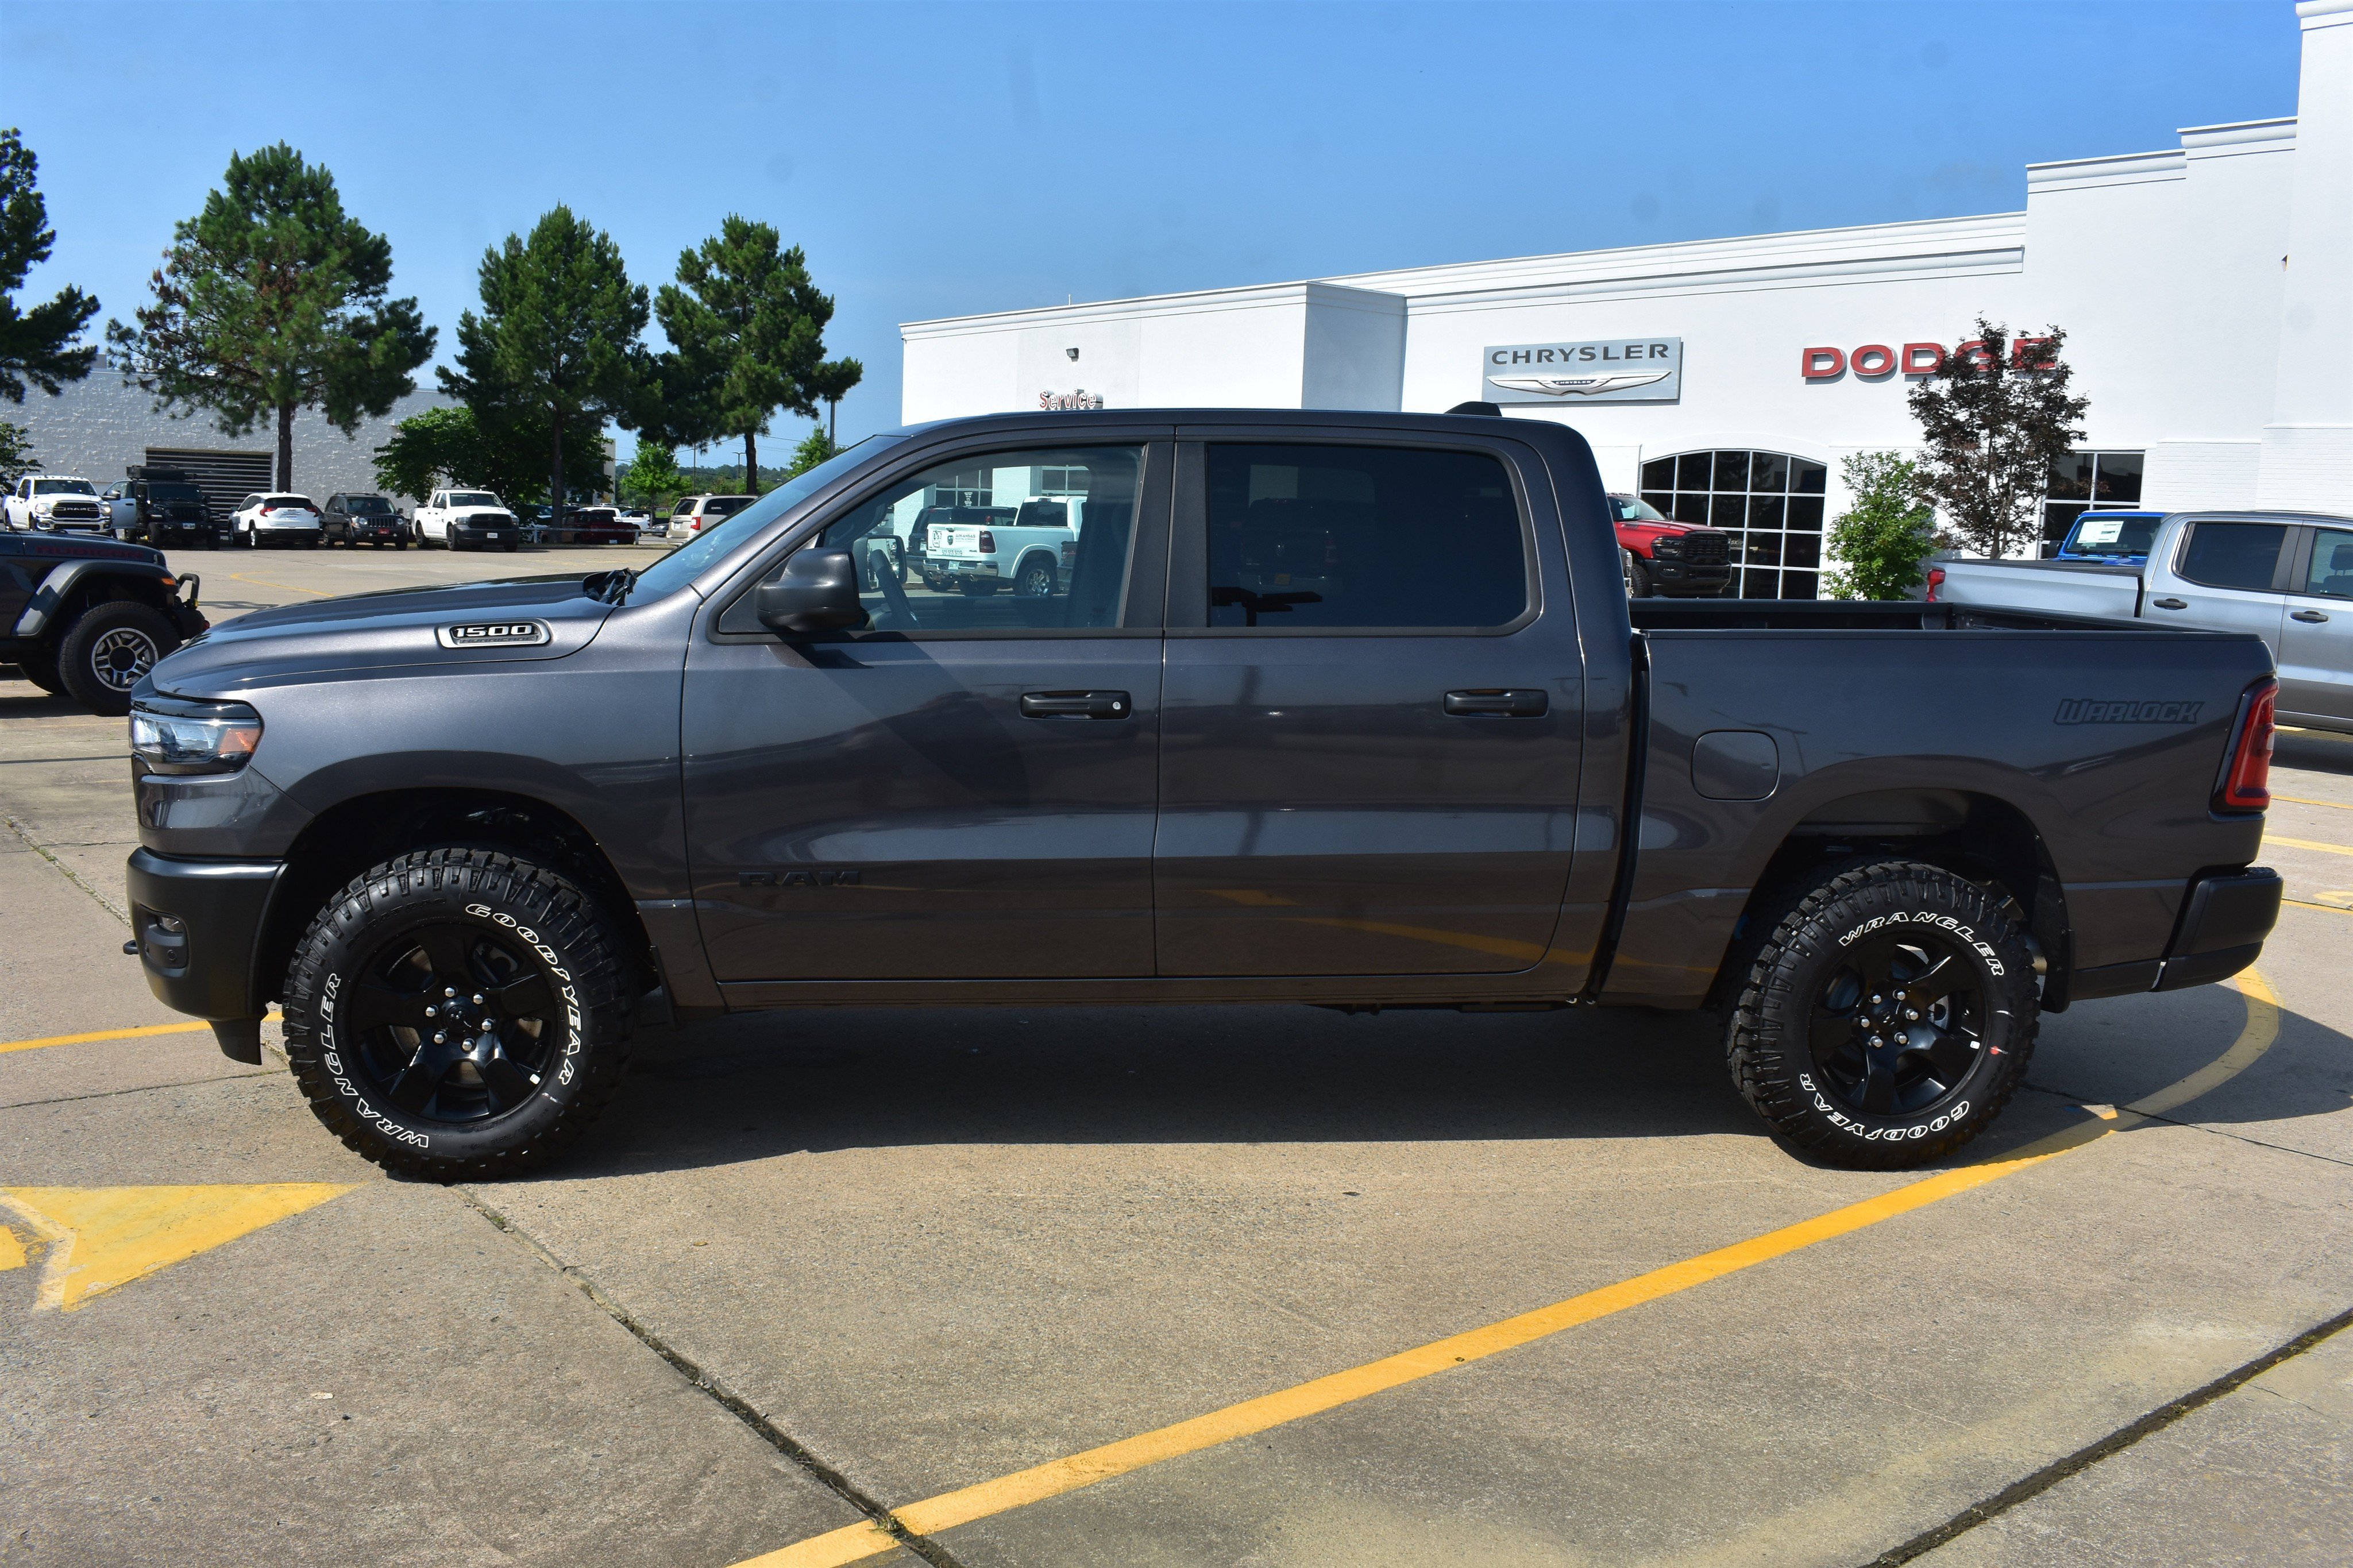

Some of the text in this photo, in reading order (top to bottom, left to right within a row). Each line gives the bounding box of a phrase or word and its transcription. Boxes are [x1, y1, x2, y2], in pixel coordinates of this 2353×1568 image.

[1492, 343, 1669, 365] CHRYSLER
[1039, 388, 1097, 410] Service
[36, 546, 143, 559] RUBICON
[455, 625, 532, 638] 1500
[461, 636, 535, 644] HURRICANE
[738, 871, 861, 887] RAM
[1839, 912, 2004, 976] WRANGLER
[466, 903, 581, 1085] GOODYEAR
[321, 973, 429, 1148] WRANGLER
[1799, 1073, 1970, 1141] GOODYEAR
